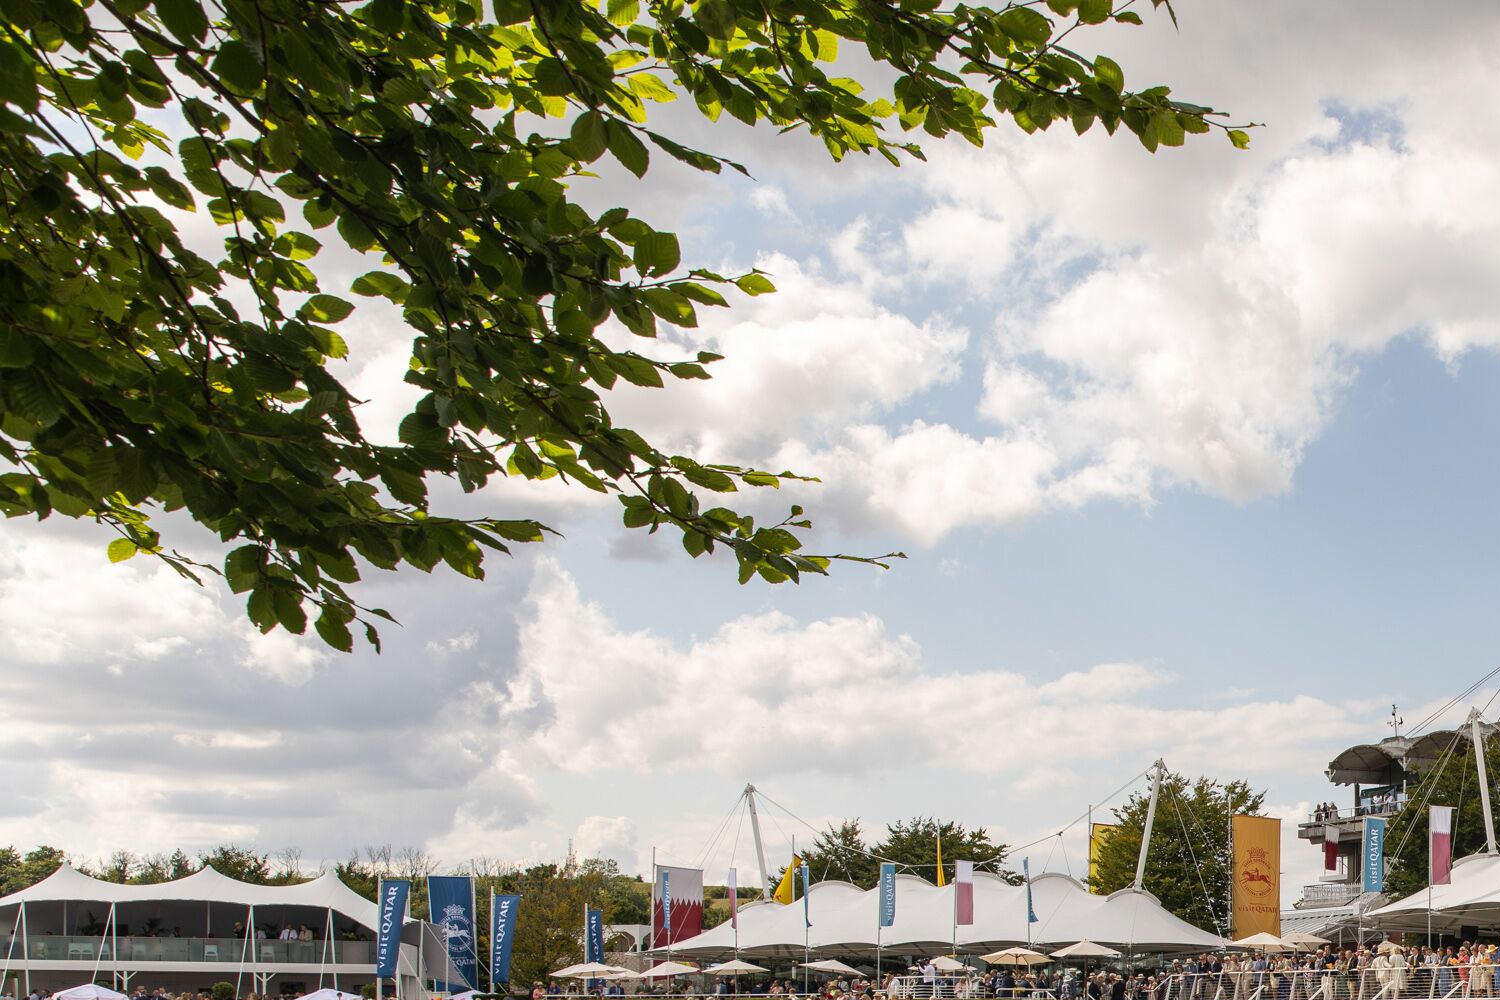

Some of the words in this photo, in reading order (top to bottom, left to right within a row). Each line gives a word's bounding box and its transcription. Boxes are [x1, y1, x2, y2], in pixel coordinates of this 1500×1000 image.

[1371, 828, 1379, 885] visitQATAR
[379, 886, 399, 969] visitQATAR
[494, 900, 511, 975] visitQATAR
